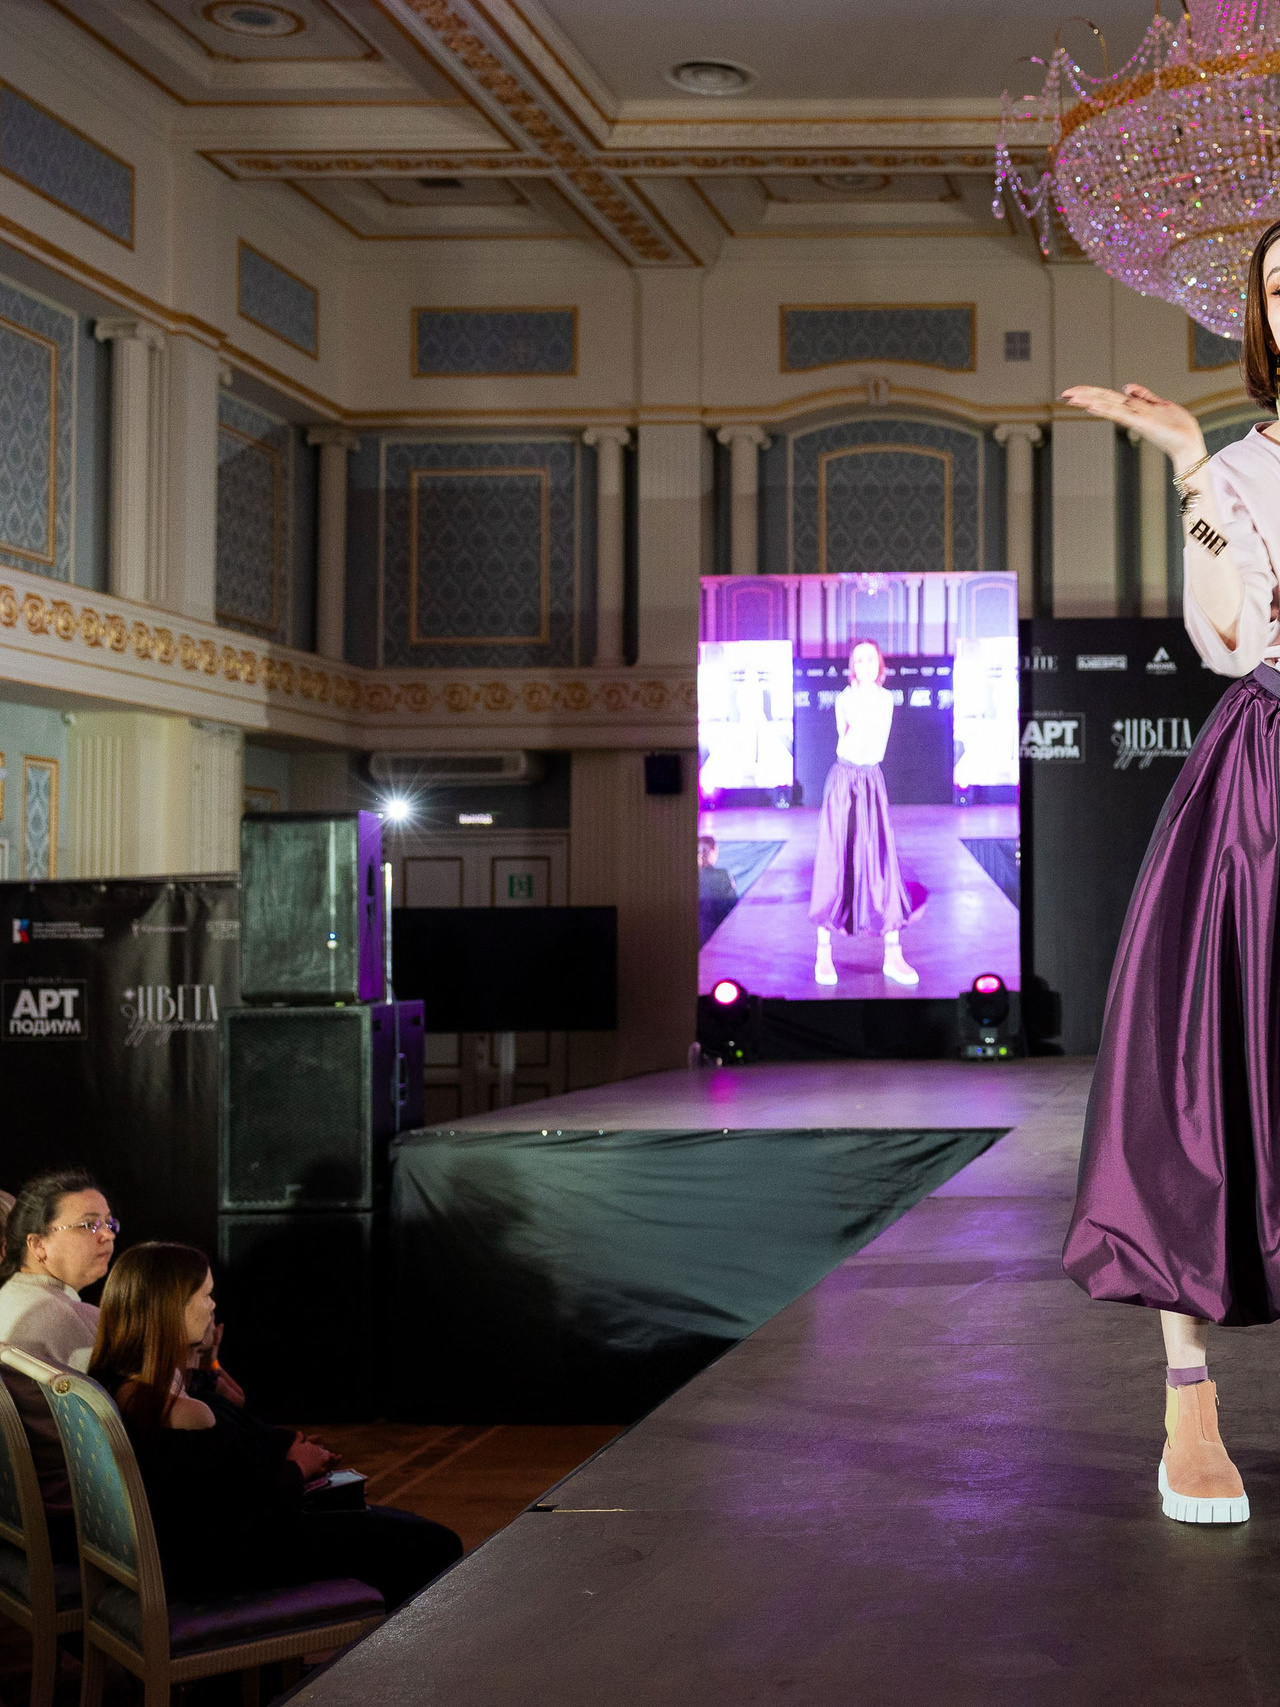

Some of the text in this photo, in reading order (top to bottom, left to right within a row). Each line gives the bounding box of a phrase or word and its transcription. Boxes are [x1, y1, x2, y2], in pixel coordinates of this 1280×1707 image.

[1021, 720, 1078, 746] АРТ
[12, 988, 79, 1019] АРТ
[9, 1019, 82, 1036] ПОДИУМ
